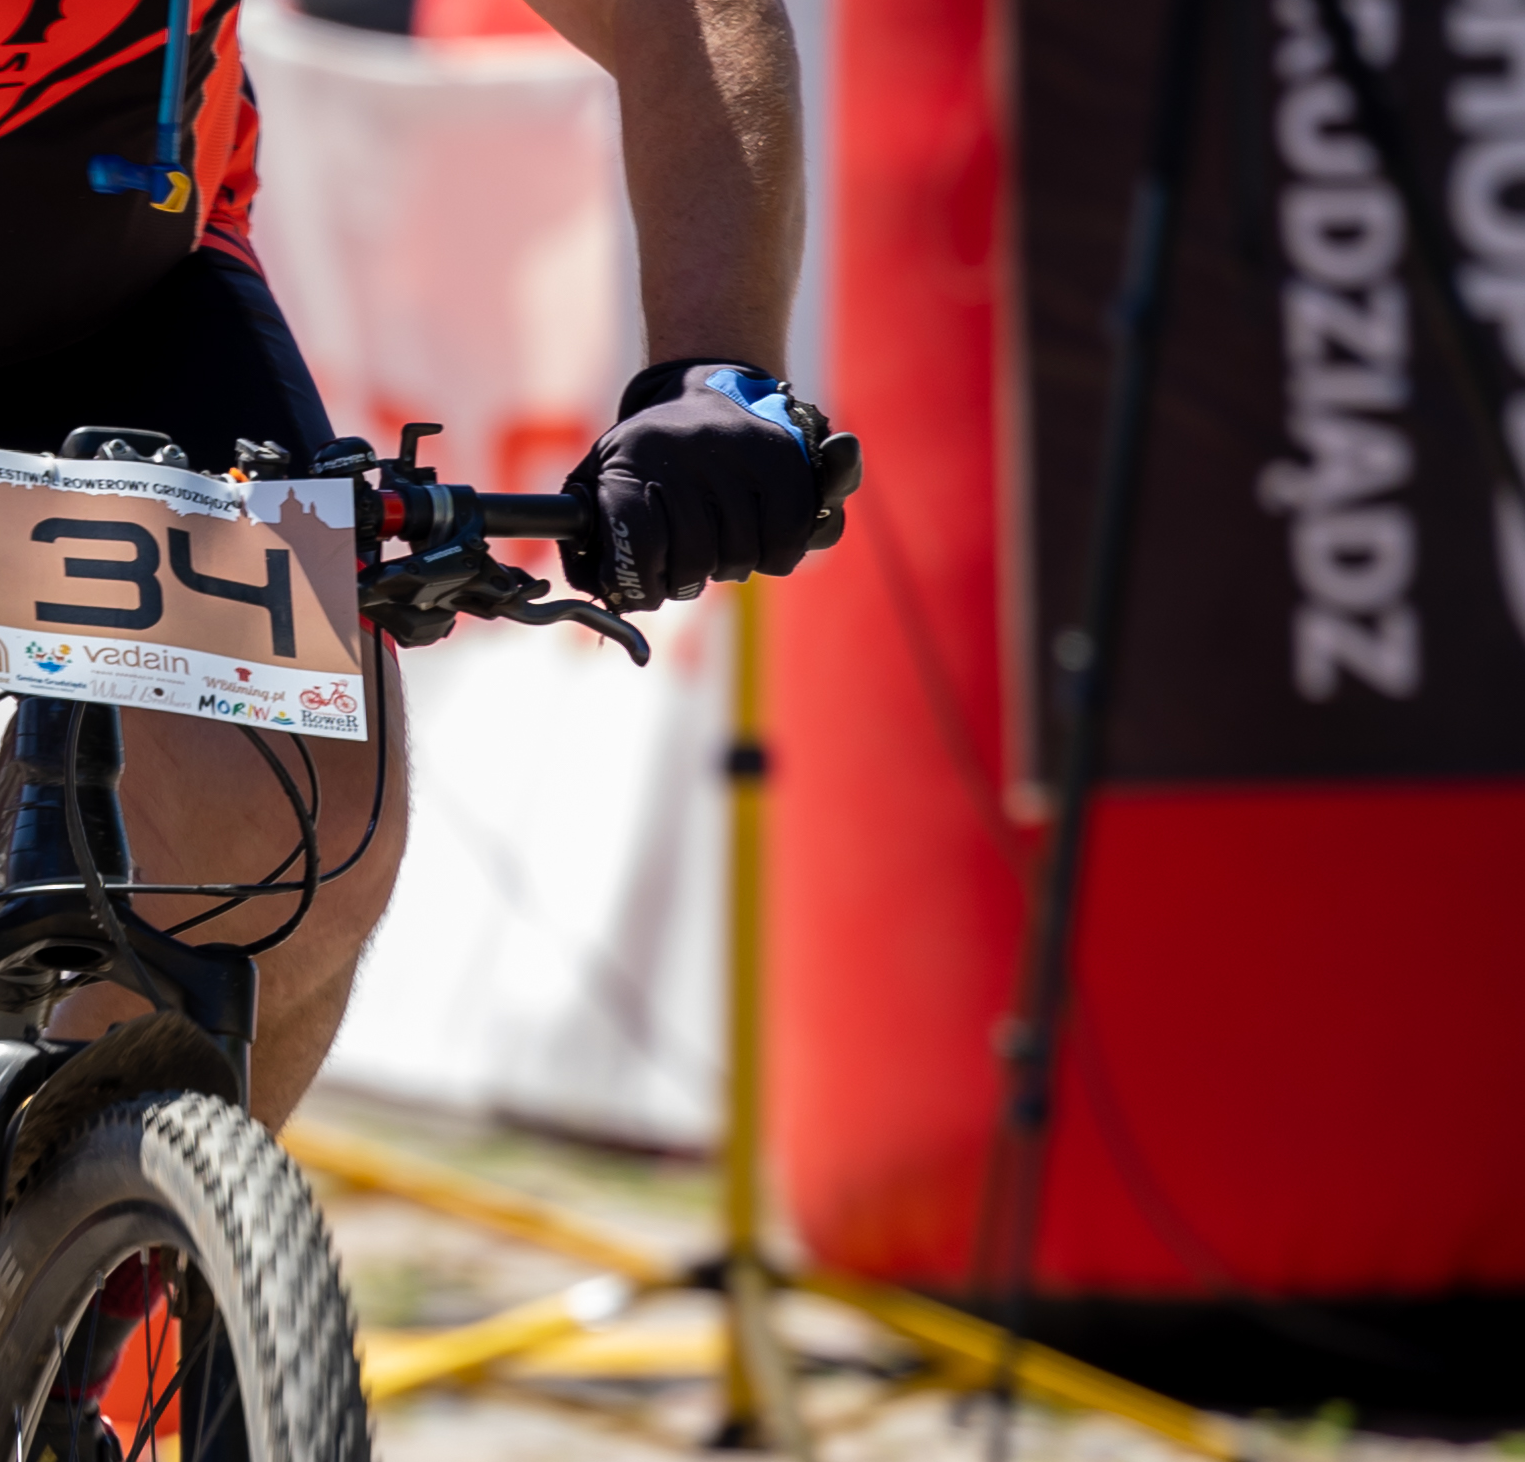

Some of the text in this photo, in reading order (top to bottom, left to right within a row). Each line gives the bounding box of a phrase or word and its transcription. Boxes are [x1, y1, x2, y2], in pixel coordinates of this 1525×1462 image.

[63, 477, 150, 493] ROWEROWY
[31, 517, 297, 658] 34
[83, 645, 192, 675] vadain
